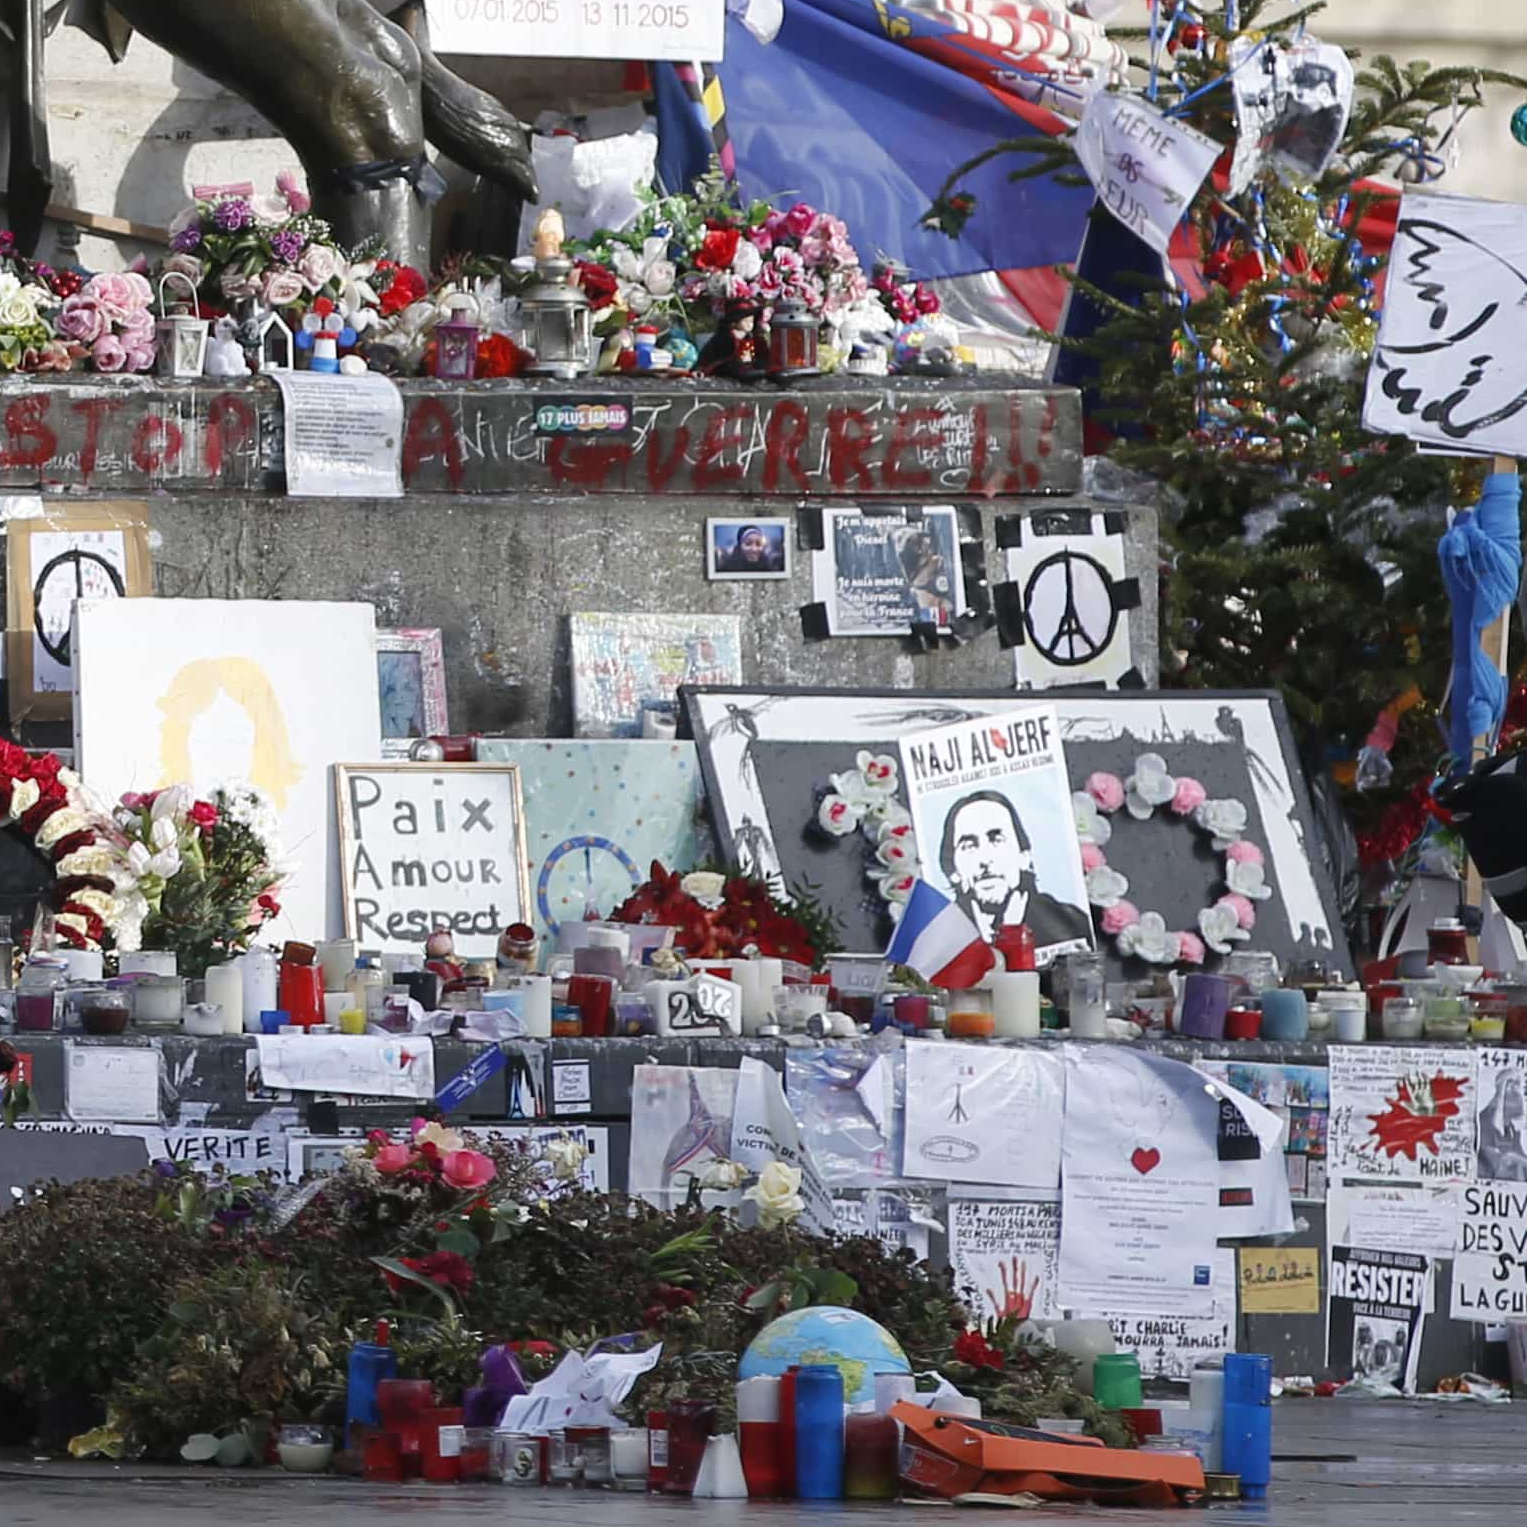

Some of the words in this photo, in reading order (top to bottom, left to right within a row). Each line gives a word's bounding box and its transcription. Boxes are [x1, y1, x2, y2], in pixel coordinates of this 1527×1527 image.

[539, 409, 554, 427] 17
[554, 408, 585, 426] PLUS
[585, 407, 628, 427] JAMAIS
[909, 735, 964, 781] NAJI
[970, 728, 997, 768] AL
[1003, 714, 1053, 759] JERF
[348, 774, 495, 840] Paix
[353, 897, 504, 943] Respect
[1461, 1222, 1504, 1252] DES
[1459, 1283, 1491, 1309] LA
